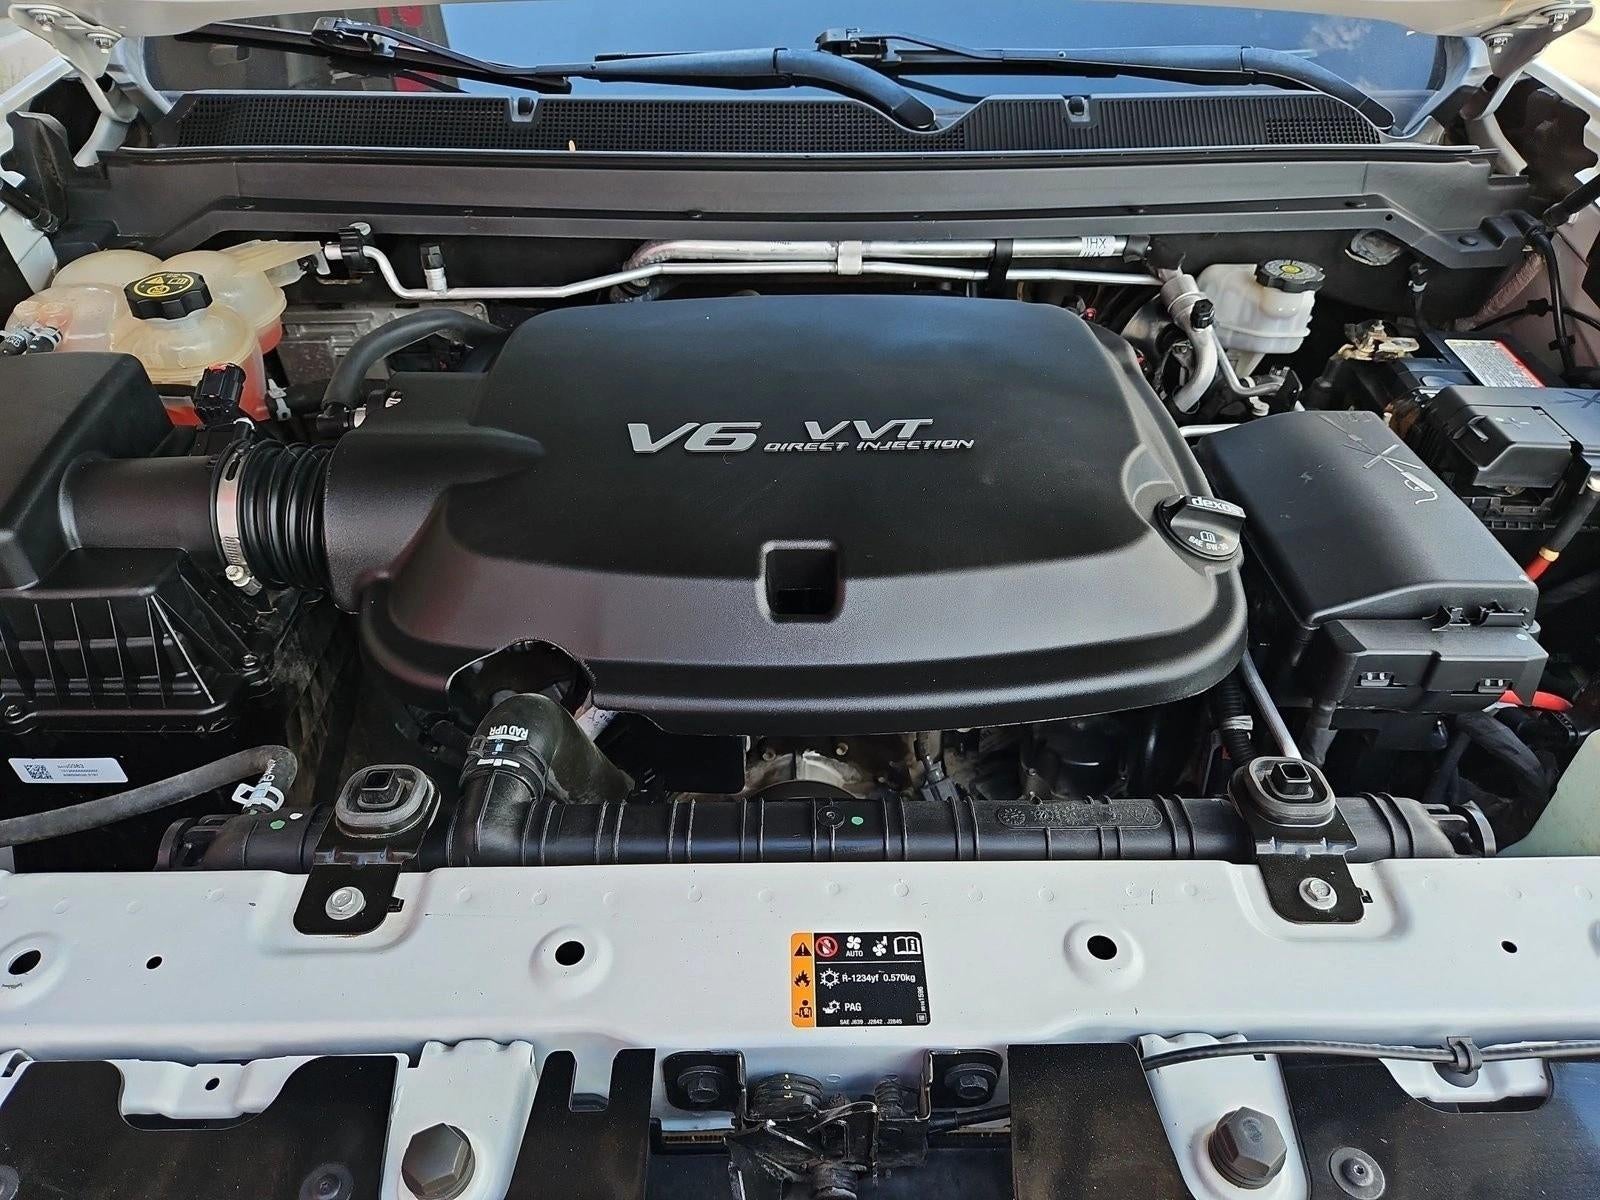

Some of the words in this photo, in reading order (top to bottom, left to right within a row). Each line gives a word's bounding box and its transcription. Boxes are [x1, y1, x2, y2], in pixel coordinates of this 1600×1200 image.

[1086, 237, 1106, 248] IHX
[627, 421, 762, 453] V6
[804, 418, 934, 441] VVT
[763, 441, 850, 453] DIRECT
[856, 439, 975, 452] INJECTION
[489, 724, 508, 736] UPR
[508, 725, 529, 739] RAD
[842, 973, 879, 984] R-1234yf
[883, 973, 916, 983] 0.570kg
[844, 1002, 862, 1012] PAG
